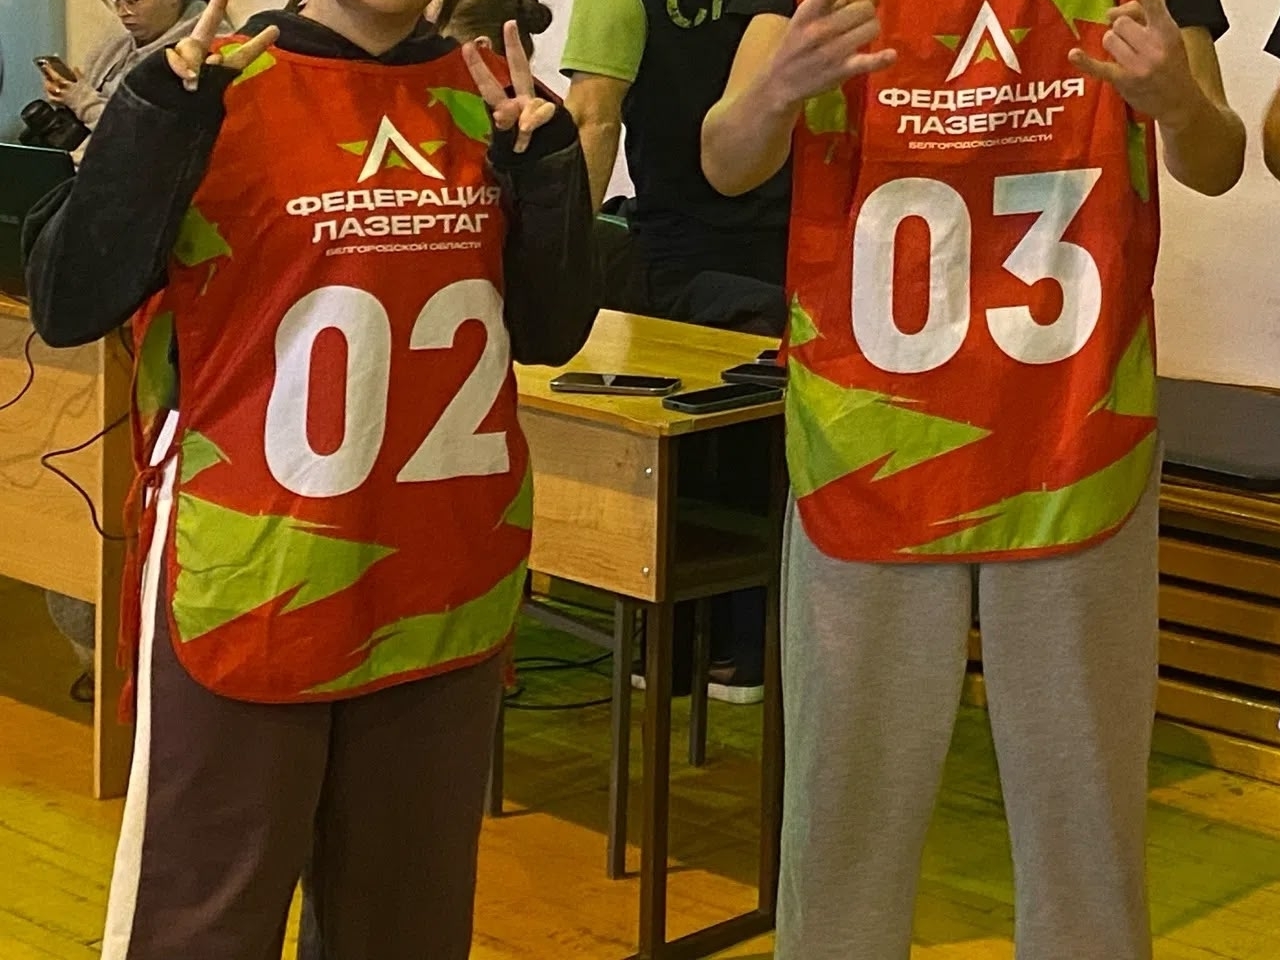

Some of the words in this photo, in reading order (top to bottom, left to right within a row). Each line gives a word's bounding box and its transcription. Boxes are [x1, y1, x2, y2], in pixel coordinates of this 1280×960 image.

[878, 77, 1085, 111] ФЕДЕРАЦИЯ
[897, 106, 1064, 134] ЛАЗЕРТАГ
[1001, 133, 1053, 145] ОБЛАСТИ
[286, 186, 500, 216] ФЕДЕРАЦИЯ
[312, 213, 488, 243] ЛАЗЕРТАГ
[325, 242, 428, 256] БЕЛГОРОДСКОЙ
[429, 241, 482, 250] ОБЛАСТИ
[852, 168, 1102, 373] 03
[264, 279, 511, 498] 02
